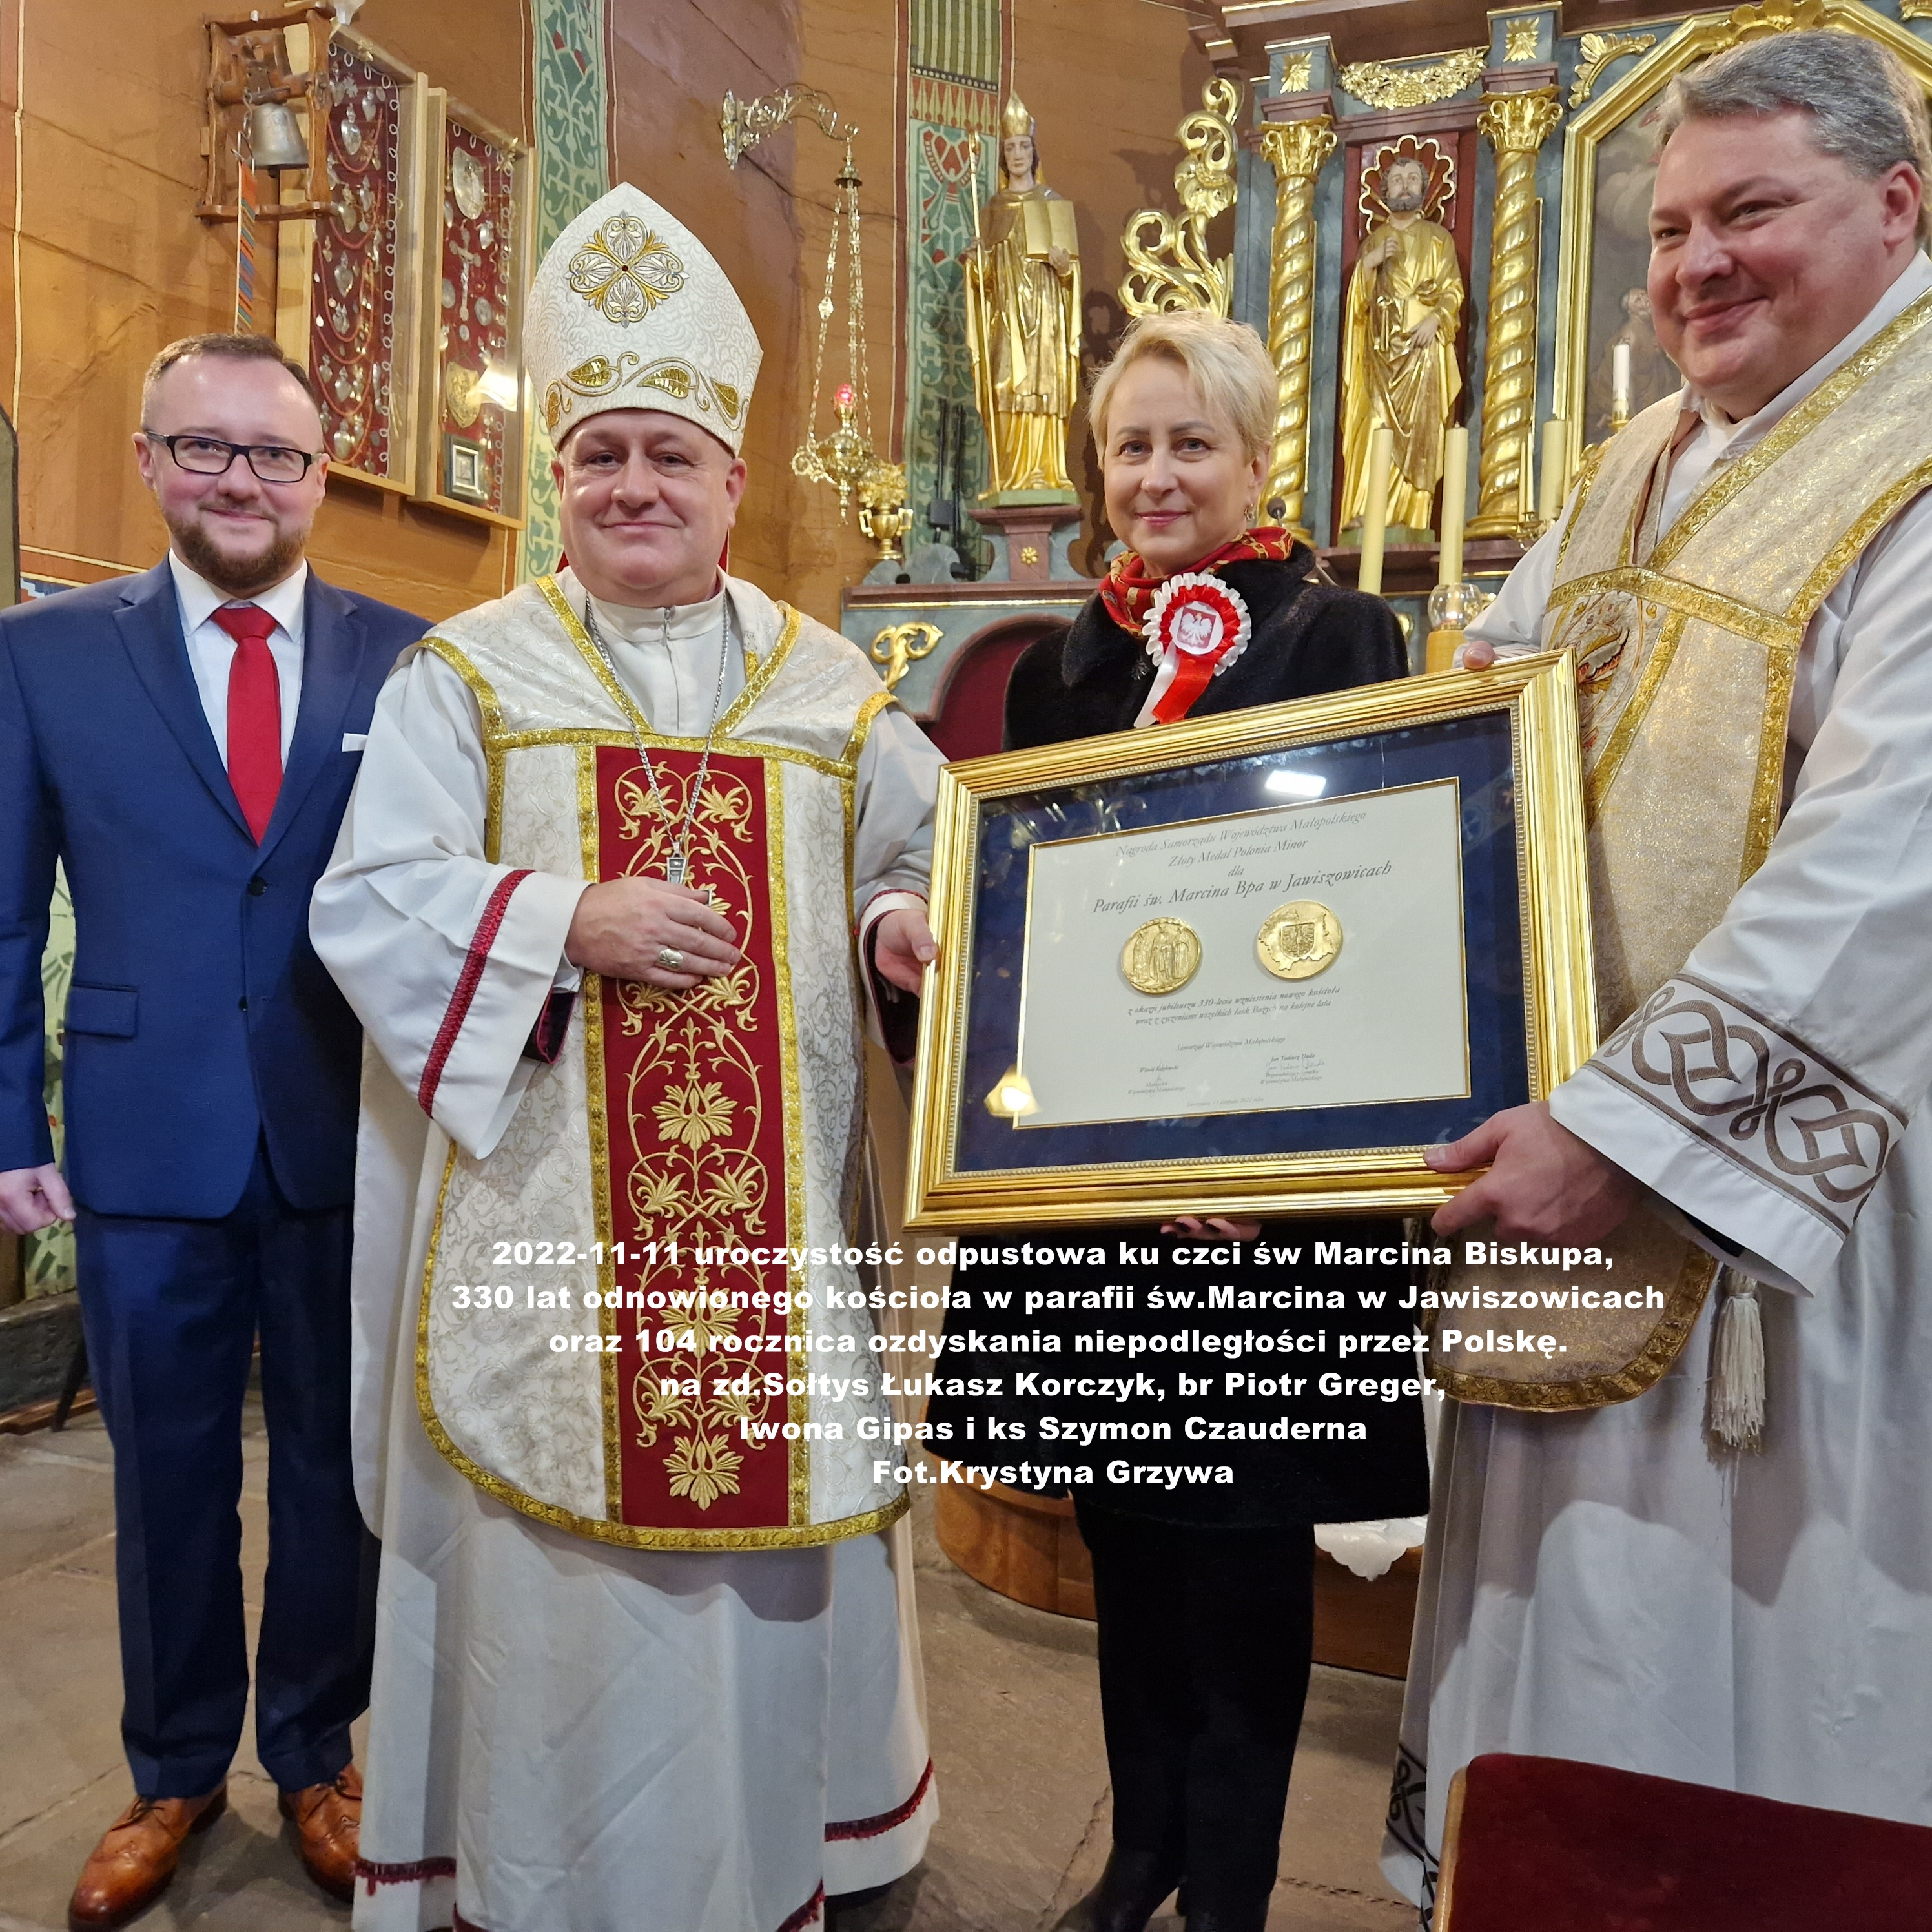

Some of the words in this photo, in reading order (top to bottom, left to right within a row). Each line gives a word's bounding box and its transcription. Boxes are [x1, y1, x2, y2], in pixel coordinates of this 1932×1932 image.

[1116, 840, 1158, 858] Nagroda
[1168, 856, 1195, 868] Złoty
[1198, 848, 1230, 863] Medal
[1233, 845, 1271, 858] Polonia
[1273, 839, 1309, 852] Minor
[1228, 865, 1245, 878] dla
[1092, 894, 1141, 914] Parafii
[1143, 893, 1162, 907] św.
[1168, 885, 1229, 903] Marcina
[1234, 880, 1264, 898] Bpa
[1269, 879, 1282, 890] w
[1283, 860, 1392, 892] Jawiszowicach
[1279, 991, 1306, 1000] nowego
[1308, 985, 1341, 997] kościoła
